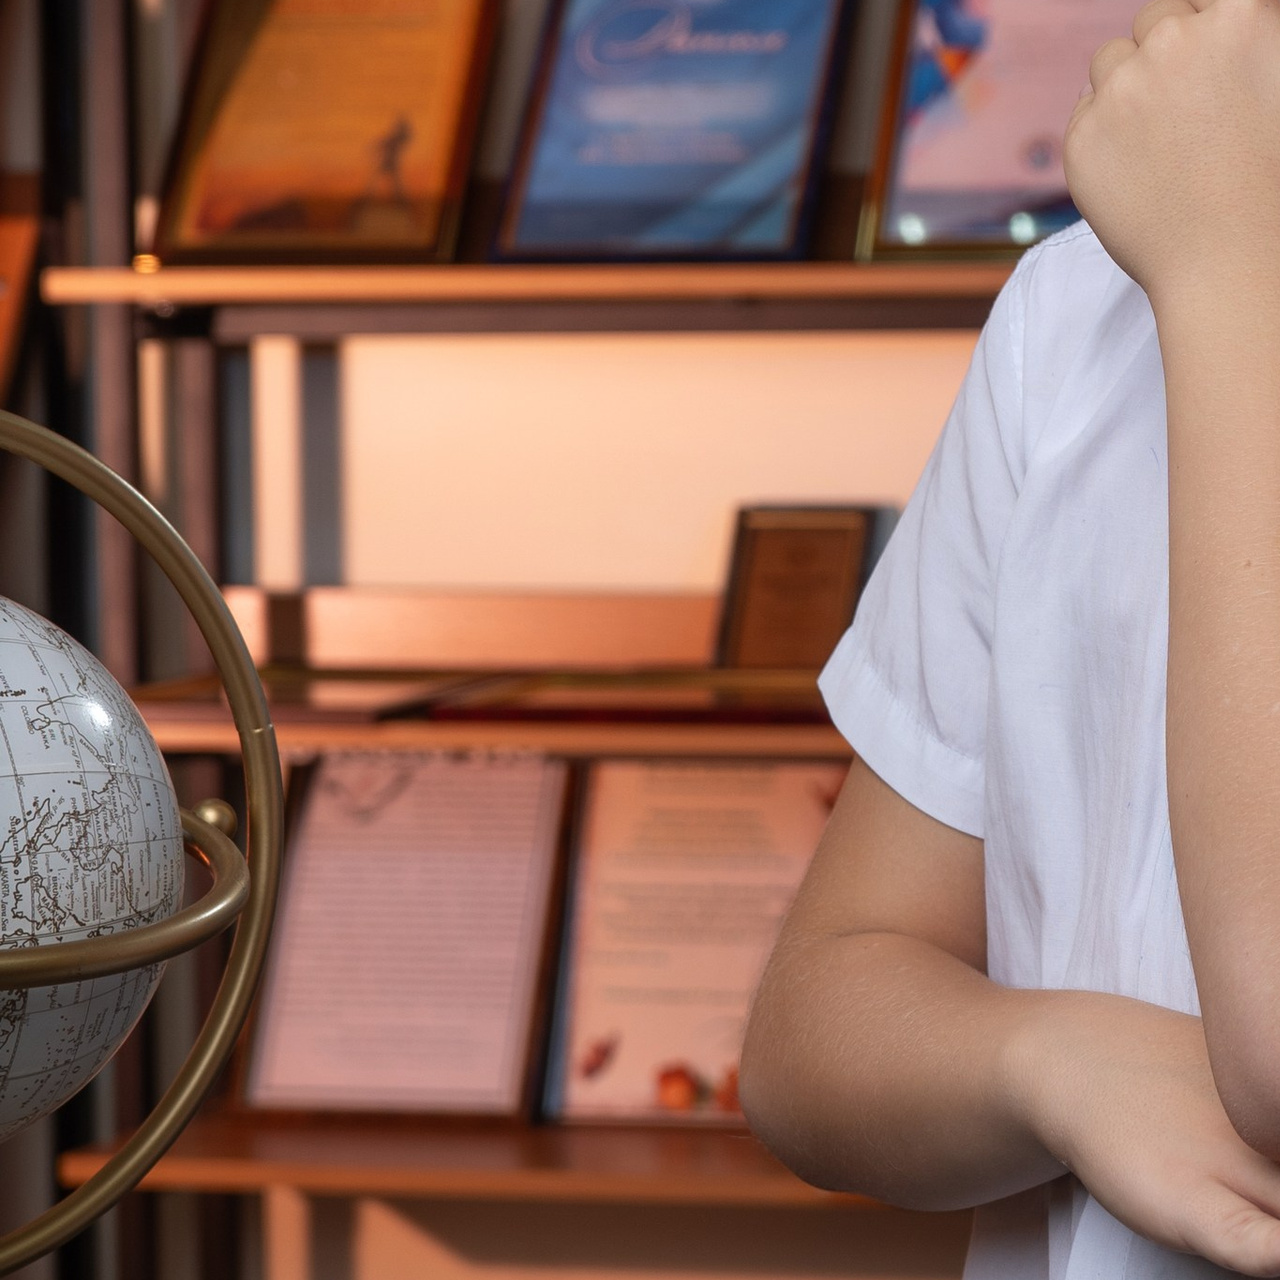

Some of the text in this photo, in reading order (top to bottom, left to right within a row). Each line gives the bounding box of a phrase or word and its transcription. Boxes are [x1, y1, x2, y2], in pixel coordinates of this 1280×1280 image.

[48, 728, 57, 741] SRI
[0, 899, 9, 917] Java
[0, 917, 10, 933] Sea
